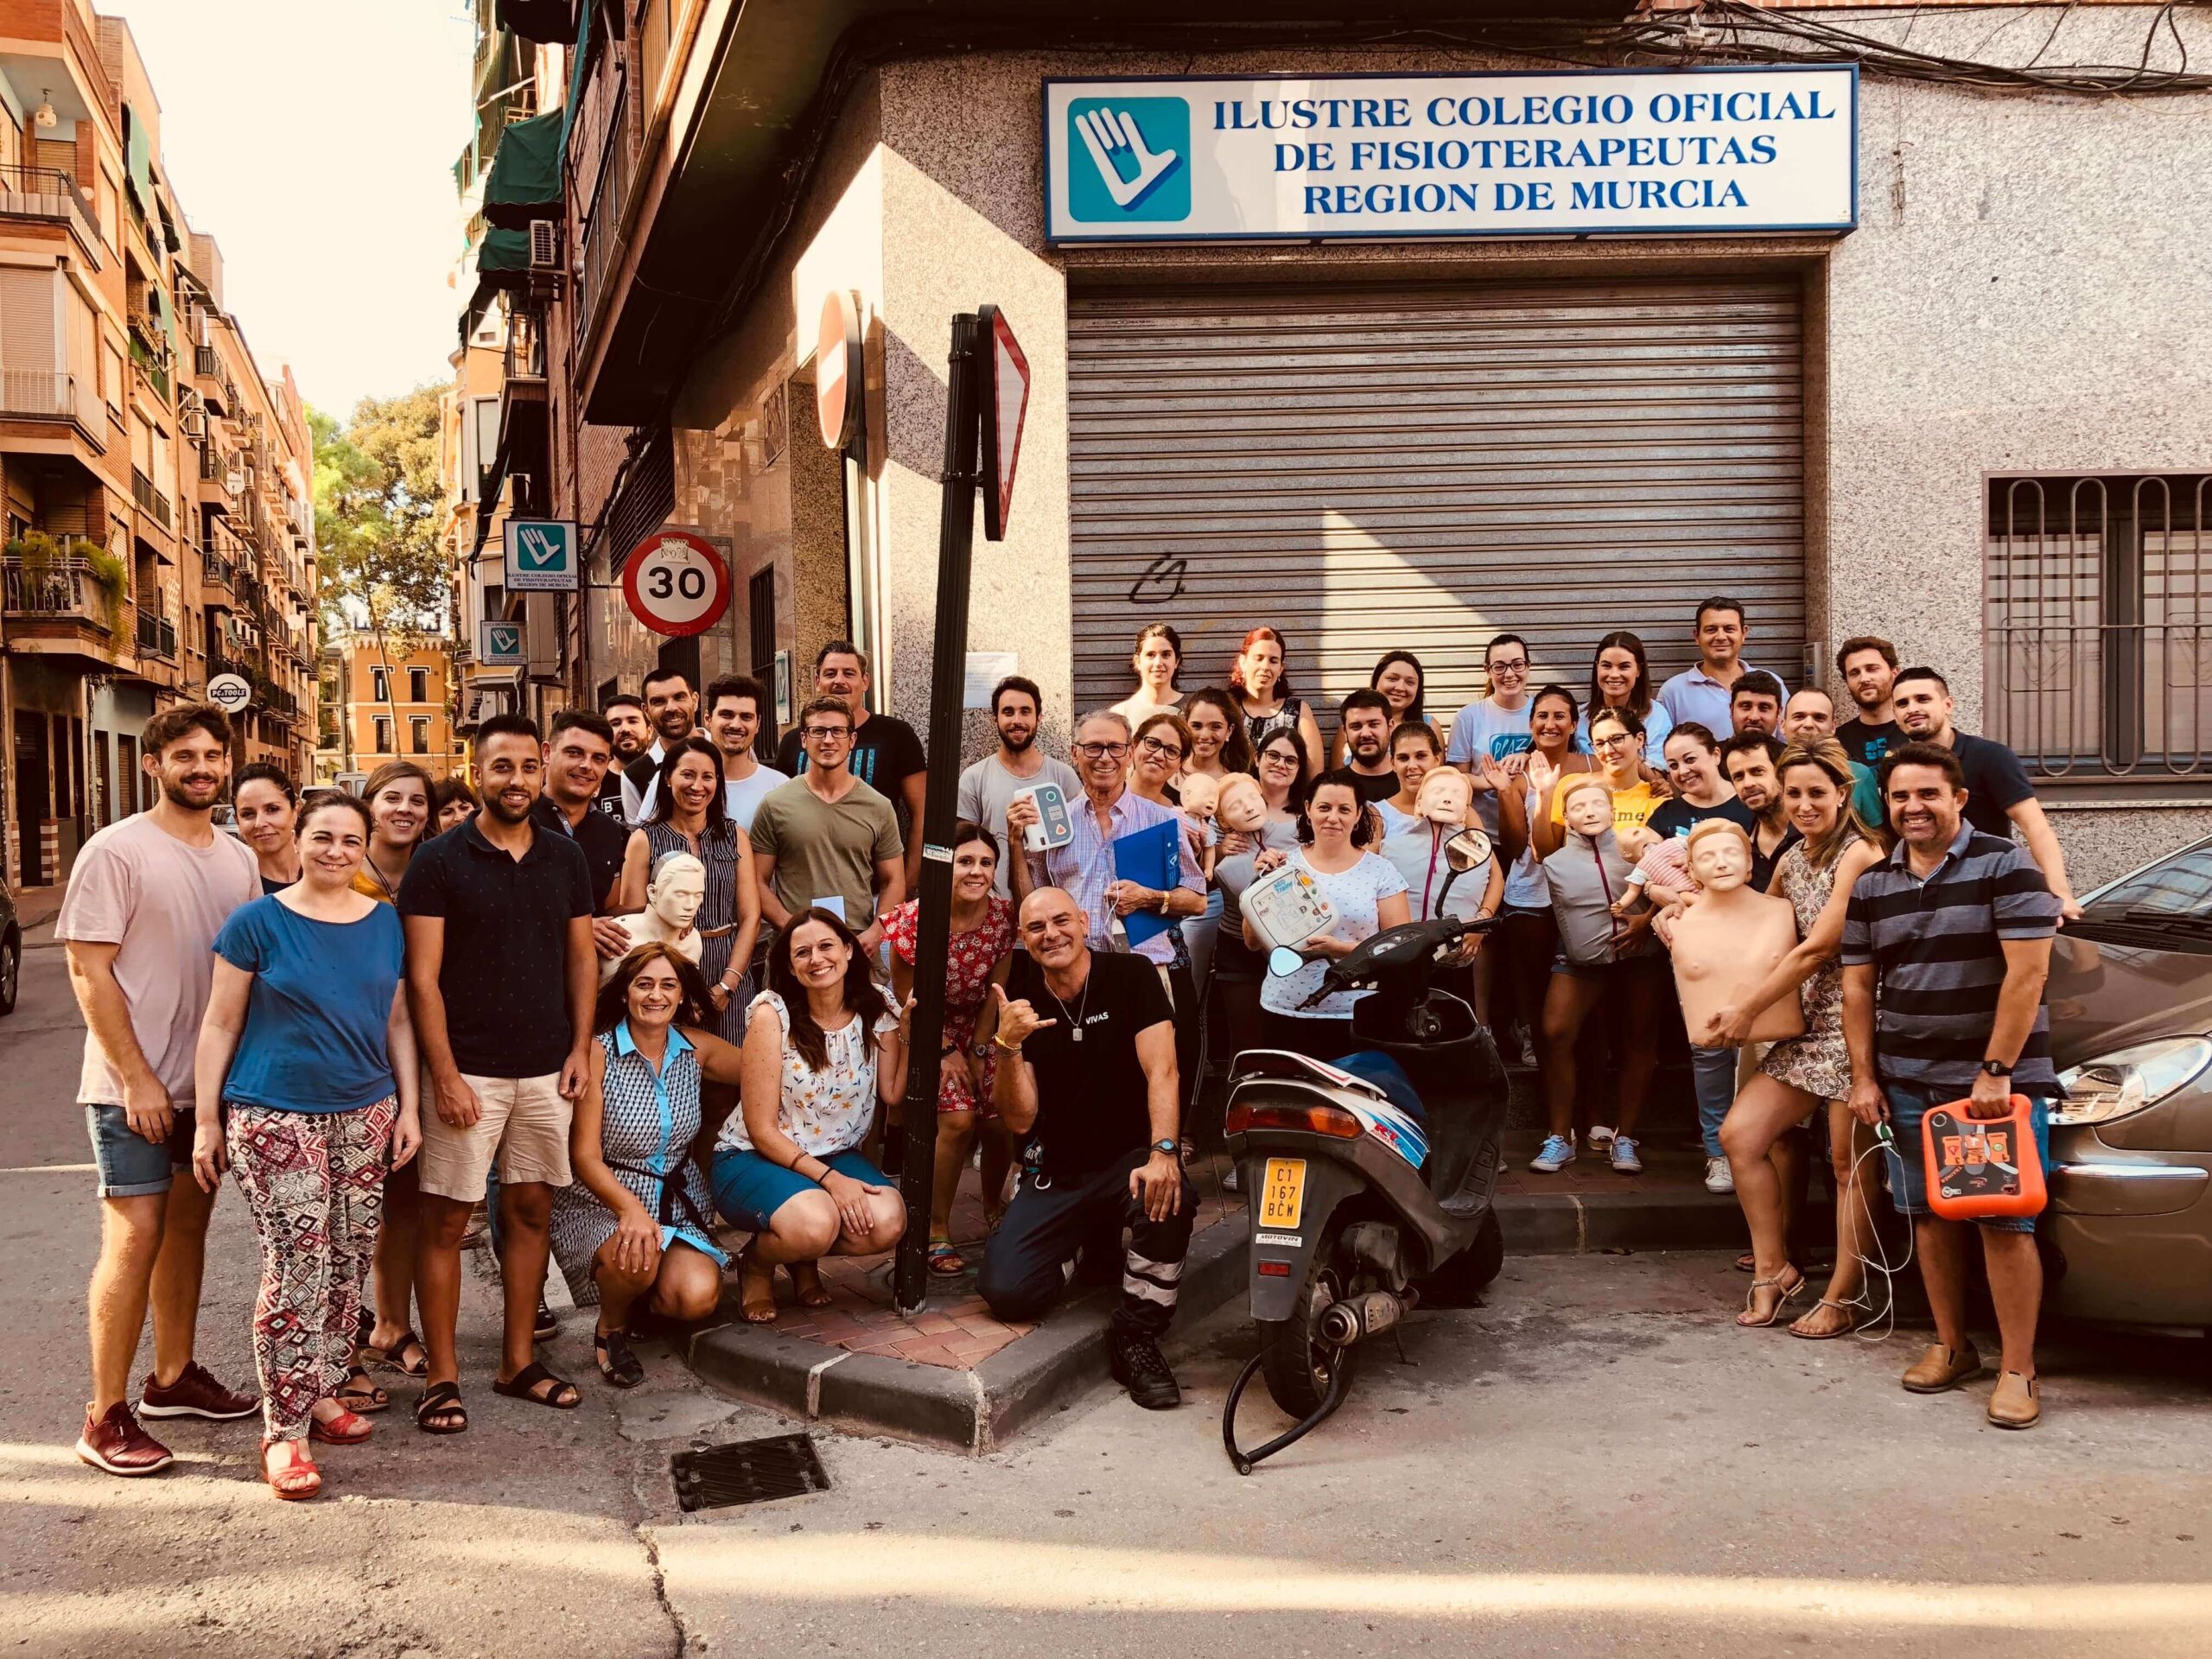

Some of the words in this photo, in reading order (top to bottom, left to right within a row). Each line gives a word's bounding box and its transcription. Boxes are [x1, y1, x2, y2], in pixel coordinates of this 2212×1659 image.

[1213, 98, 1412, 130] ILUSTRE
[1427, 95, 1634, 127] COLEGIO
[1649, 91, 1837, 123] OFICIAL
[1274, 143, 1336, 171] DE
[1350, 135, 1777, 170] FISIOTERAPEUTAS
[1303, 182, 1479, 214] REGION
[1493, 182, 1555, 211] DE
[1569, 179, 1750, 210] MURCIA
[648, 566, 706, 600] 30
[1611, 808, 1645, 822] ime
[1085, 1011, 1109, 1025] VIVAS
[1277, 1168, 1292, 1182] C1
[1272, 1185, 1295, 1199] 167
